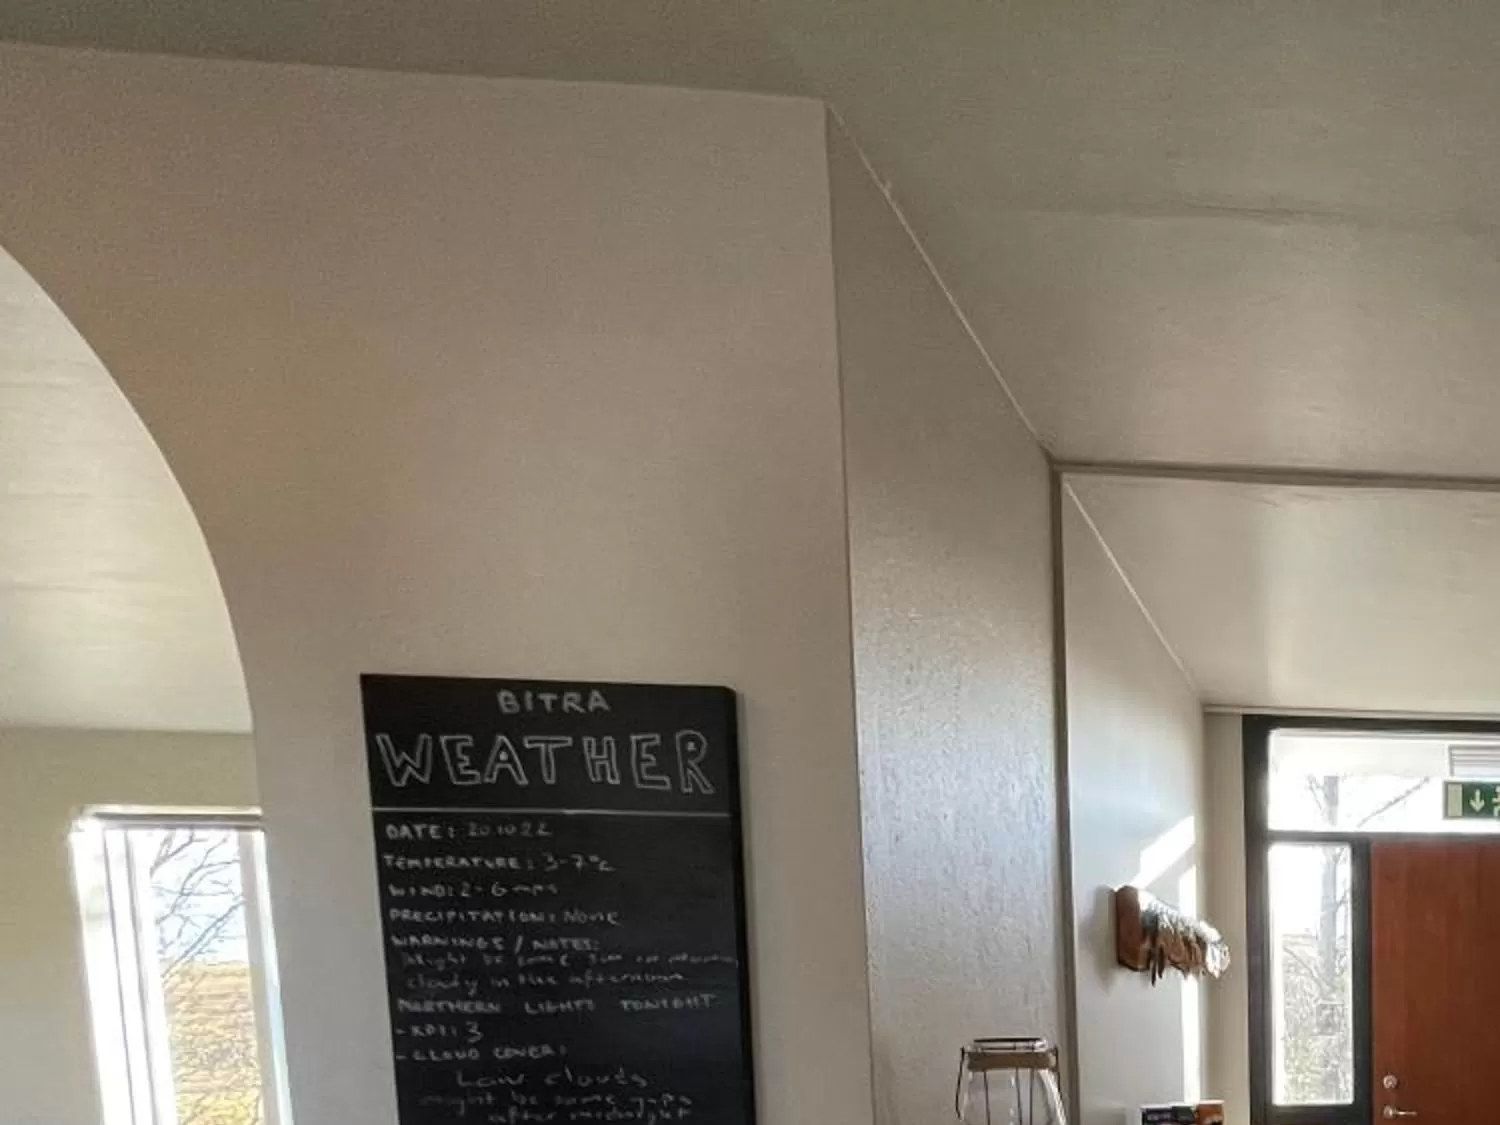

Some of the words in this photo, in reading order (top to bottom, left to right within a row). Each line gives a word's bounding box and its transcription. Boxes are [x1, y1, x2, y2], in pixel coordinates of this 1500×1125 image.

[376, 730, 714, 794] WEATHER
[385, 824, 454, 840] DATE:
[383, 853, 535, 871] TEMPERATURE:
[388, 908, 556, 925] PRECIPITATION:
